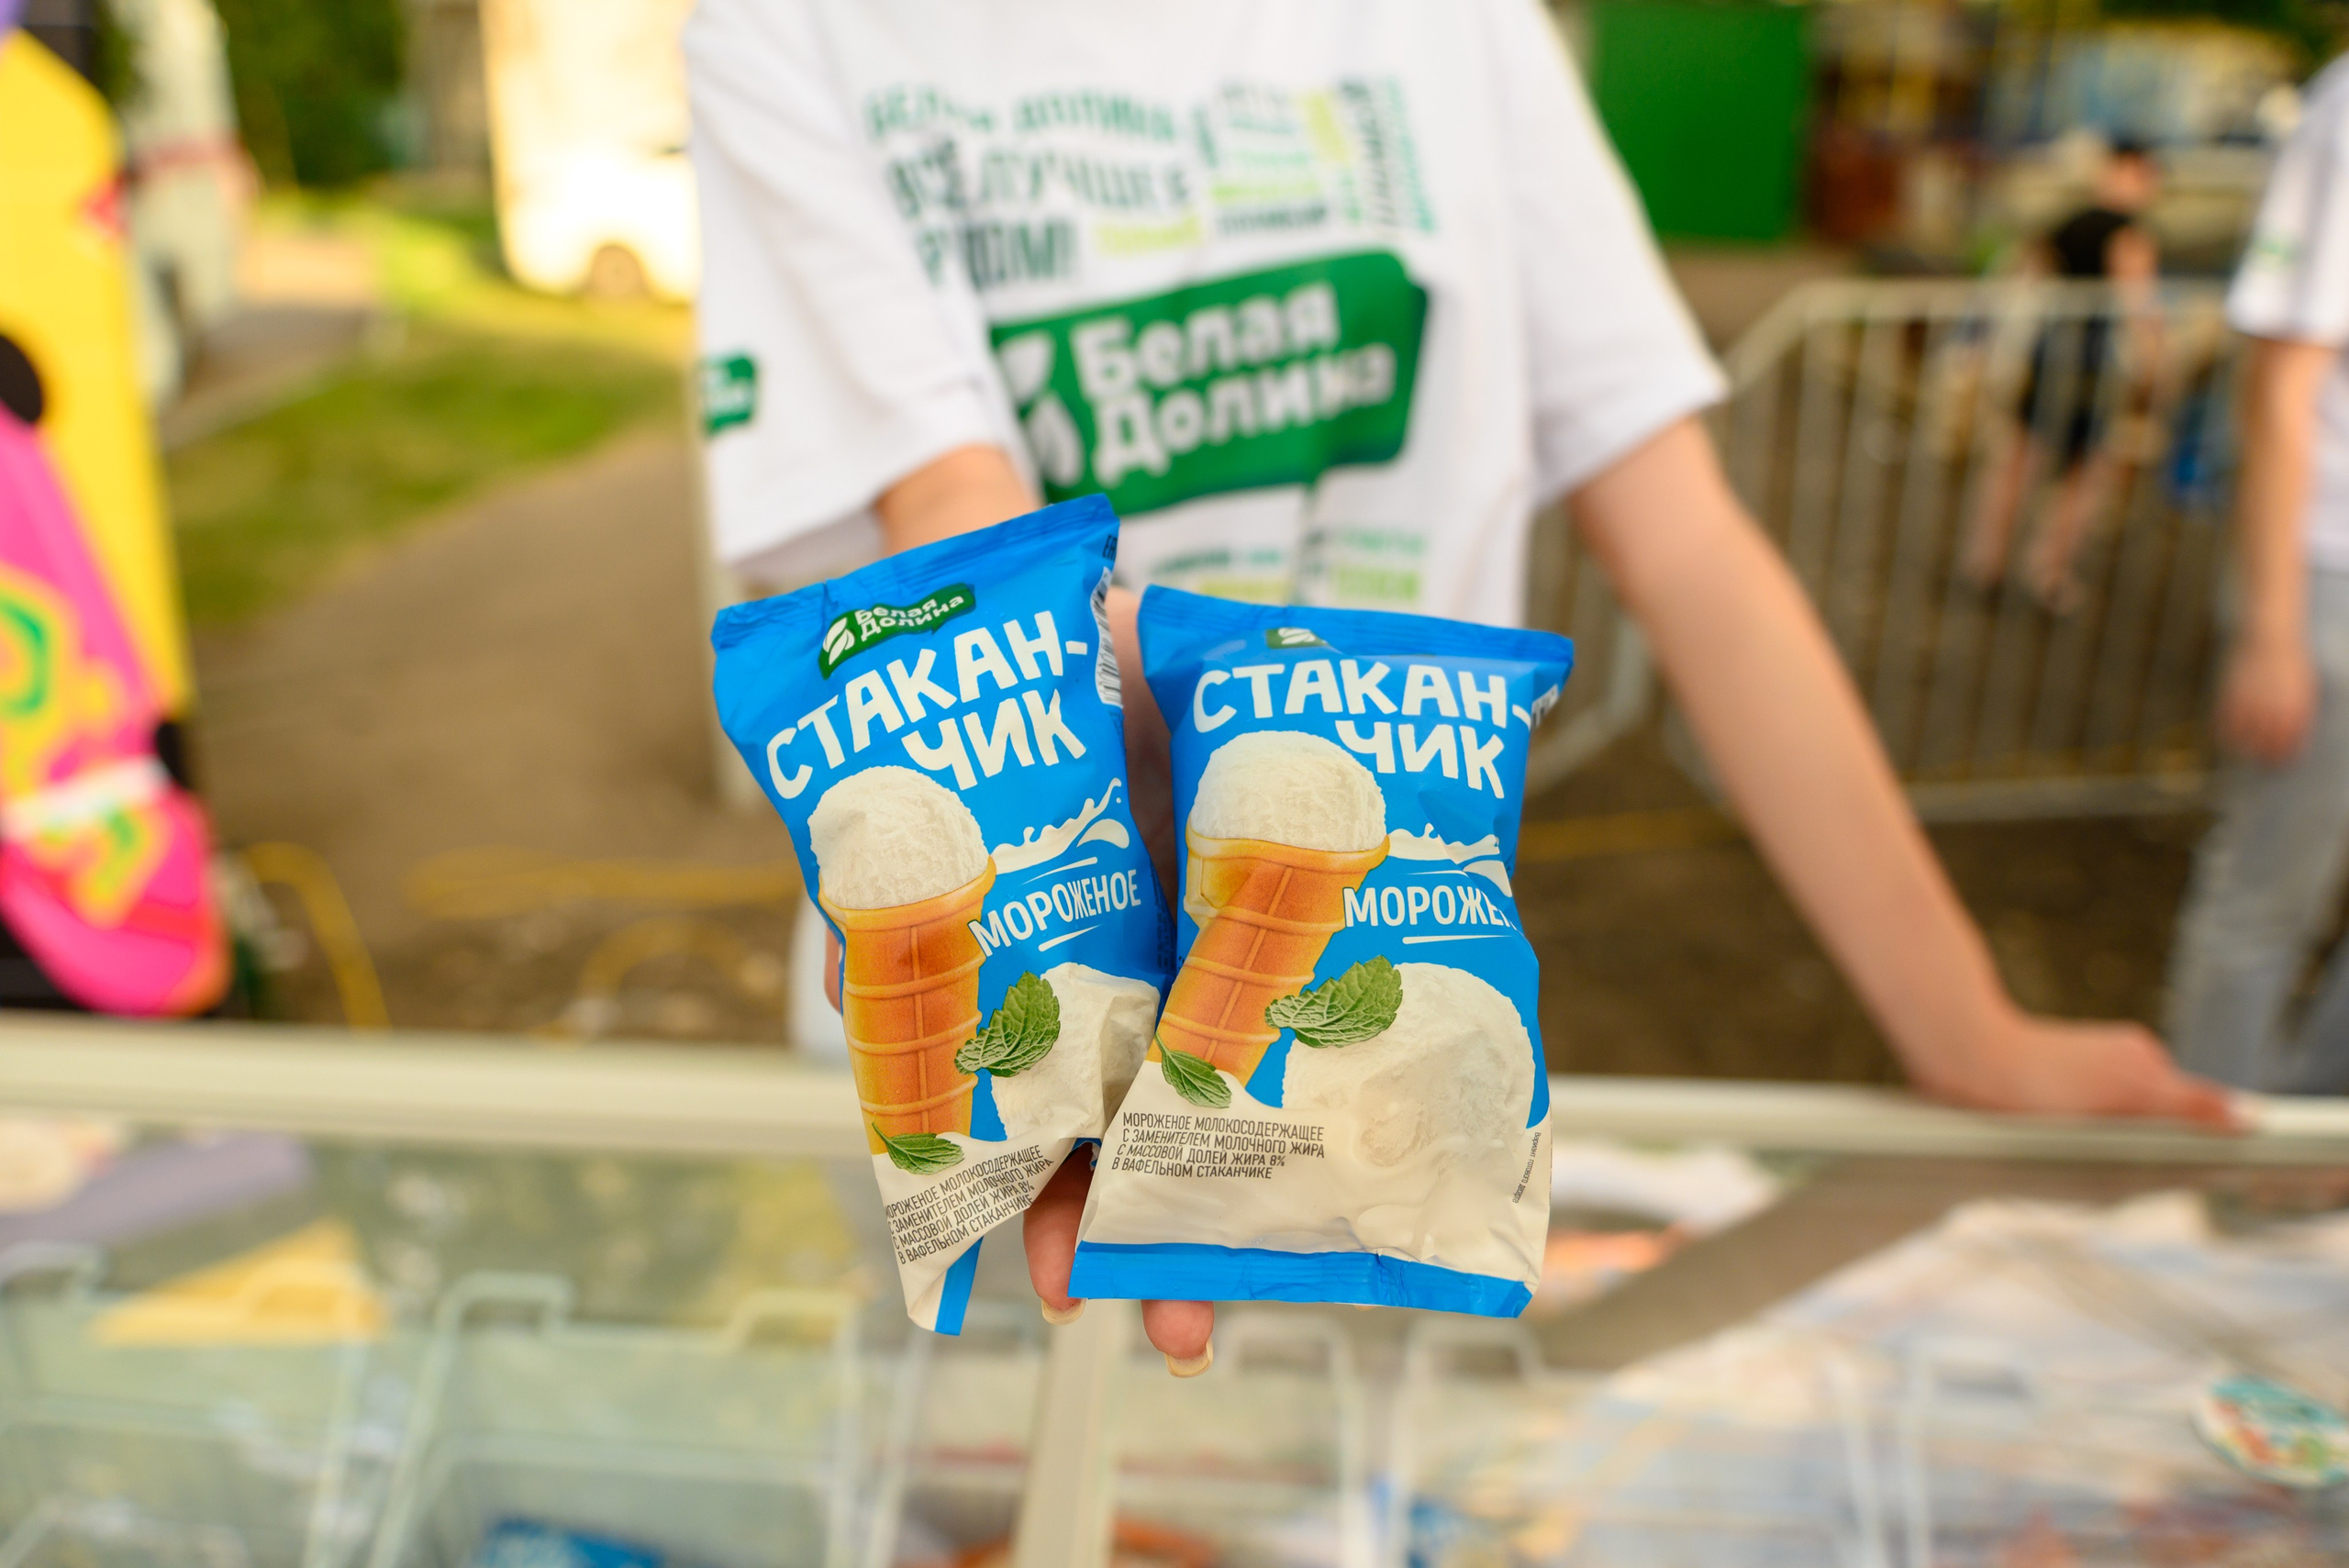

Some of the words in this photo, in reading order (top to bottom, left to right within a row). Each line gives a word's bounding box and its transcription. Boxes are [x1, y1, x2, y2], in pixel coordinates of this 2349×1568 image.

[1069, 280, 1341, 400] Белая
[1093, 342, 1397, 486] Долина
[854, 598, 938, 625] Белая
[861, 596, 964, 641] Долина
[766, 611, 1087, 799] СТАКАН-
[1193, 660, 1531, 732] СТАКАН-
[901, 689, 1086, 791] ЧИК
[1335, 720, 1504, 799] ЧИК
[967, 869, 1141, 956] МОРОЖЕНОЕ
[1117, 1144, 1124, 1156] С
[1127, 1143, 1184, 1161] МАССОВОЙ
[1186, 1148, 1227, 1165] ДОЛЕЙ
[1230, 1153, 1265, 1166] ЖИРА
[1269, 1155, 1286, 1167] 8%
[1123, 1112, 1192, 1130] МОРОЖЕНОЕ
[1195, 1117, 1324, 1141] МОЛОКОСОДЕРЖАЩЕЕ
[1123, 1129, 1130, 1142] С
[1132, 1129, 1209, 1148] ЗАМЕНИТЕЛЕМ
[1214, 1135, 1286, 1154] МОЛОЧНОГО
[1289, 1142, 1325, 1158] ЖИРА
[893, 1190, 966, 1232] ЗАМЕНИТЕЛЕМ
[966, 1168, 1024, 1199] МОЛОЧНОГО
[1022, 1159, 1054, 1177] ЖИРА
[940, 1145, 1043, 1195] МОЛОКОСОДЕРЖАЩЕЕ
[1111, 1157, 1119, 1170] В
[1121, 1159, 1193, 1177] ВАФЕЛЬНОМ
[1197, 1165, 1273, 1179] СТАКАНЧИКЕ
[893, 1236, 899, 1250] С
[898, 1214, 952, 1248] МАССОВОЙ
[953, 1195, 990, 1226] ДОЛЕЙ
[989, 1184, 1021, 1205] ЖИРА
[1019, 1180, 1035, 1194] 8%
[898, 1251, 906, 1264] В
[906, 1224, 970, 1262] ВАФЕЛЬНОМ
[969, 1194, 1033, 1232] СТАКАНЧИКЕ
